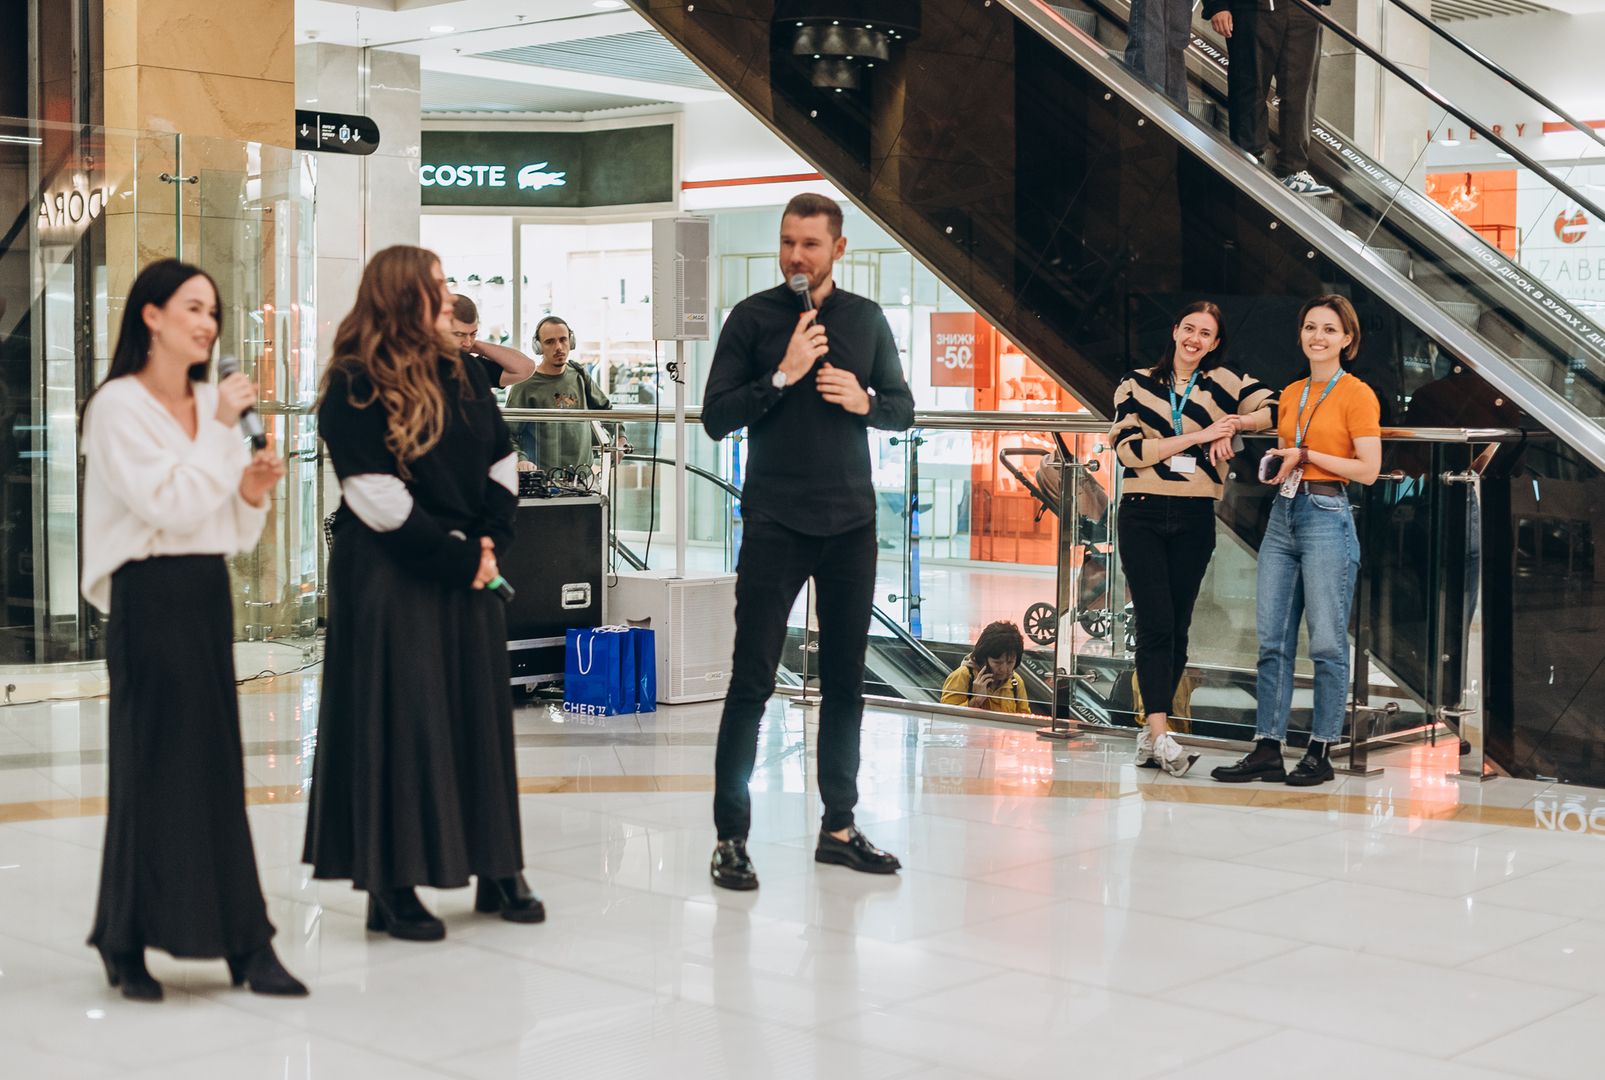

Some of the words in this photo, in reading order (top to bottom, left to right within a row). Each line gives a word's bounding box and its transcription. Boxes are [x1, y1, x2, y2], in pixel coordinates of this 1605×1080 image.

[418, 164, 507, 187] COSTE
[1193, 38, 1221, 58] БУЛИ
[1312, 127, 1342, 151] ЯСНА
[1341, 148, 1385, 180] БІЛЬШЕ
[1381, 178, 1399, 192] НЕ
[1397, 189, 1449, 228] КРОВИЛИ
[1471, 245, 1501, 267] ЩОБ
[1497, 266, 1535, 293] ДІРОК
[1531, 290, 1544, 300] В
[1542, 298, 1582, 327] ЗУБАХ
[1578, 324, 1591, 333] У
[936, 333, 985, 346] ЗНИЖКИ
